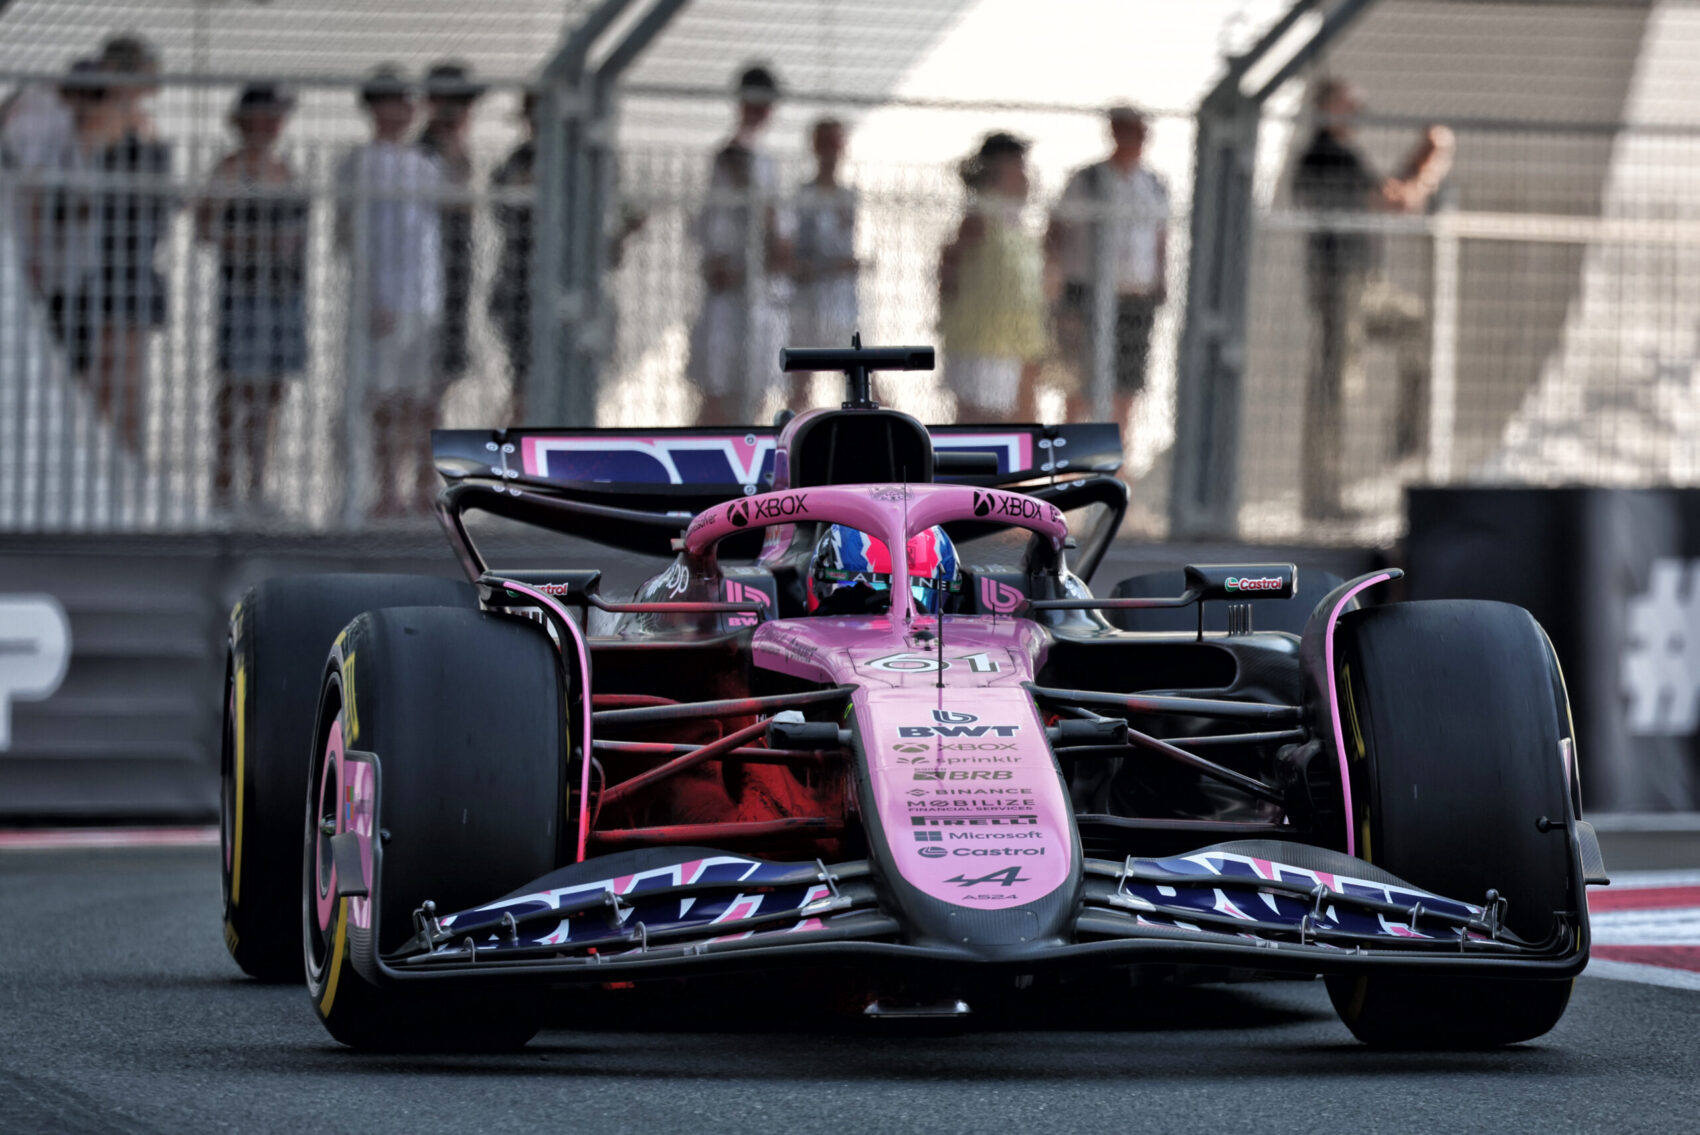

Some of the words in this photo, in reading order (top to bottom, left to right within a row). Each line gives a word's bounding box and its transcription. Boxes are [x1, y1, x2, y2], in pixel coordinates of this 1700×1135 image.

[755, 494, 808, 519] XBOX
[997, 495, 1042, 520] XBOX
[853, 572, 947, 591] ALINE
[1239, 577, 1283, 590] Castrol
[728, 617, 758, 626] BW
[864, 652, 1001, 673] 61
[898, 725, 1020, 738] BWT
[937, 743, 1018, 751] XBOX
[936, 755, 1022, 765] sprinklr
[949, 770, 1013, 780] BRB
[936, 788, 1033, 796] BINANCE
[911, 815, 1038, 826] PIRELLI
[949, 831, 1043, 840] Microsoft
[952, 847, 1046, 857] Castrol
